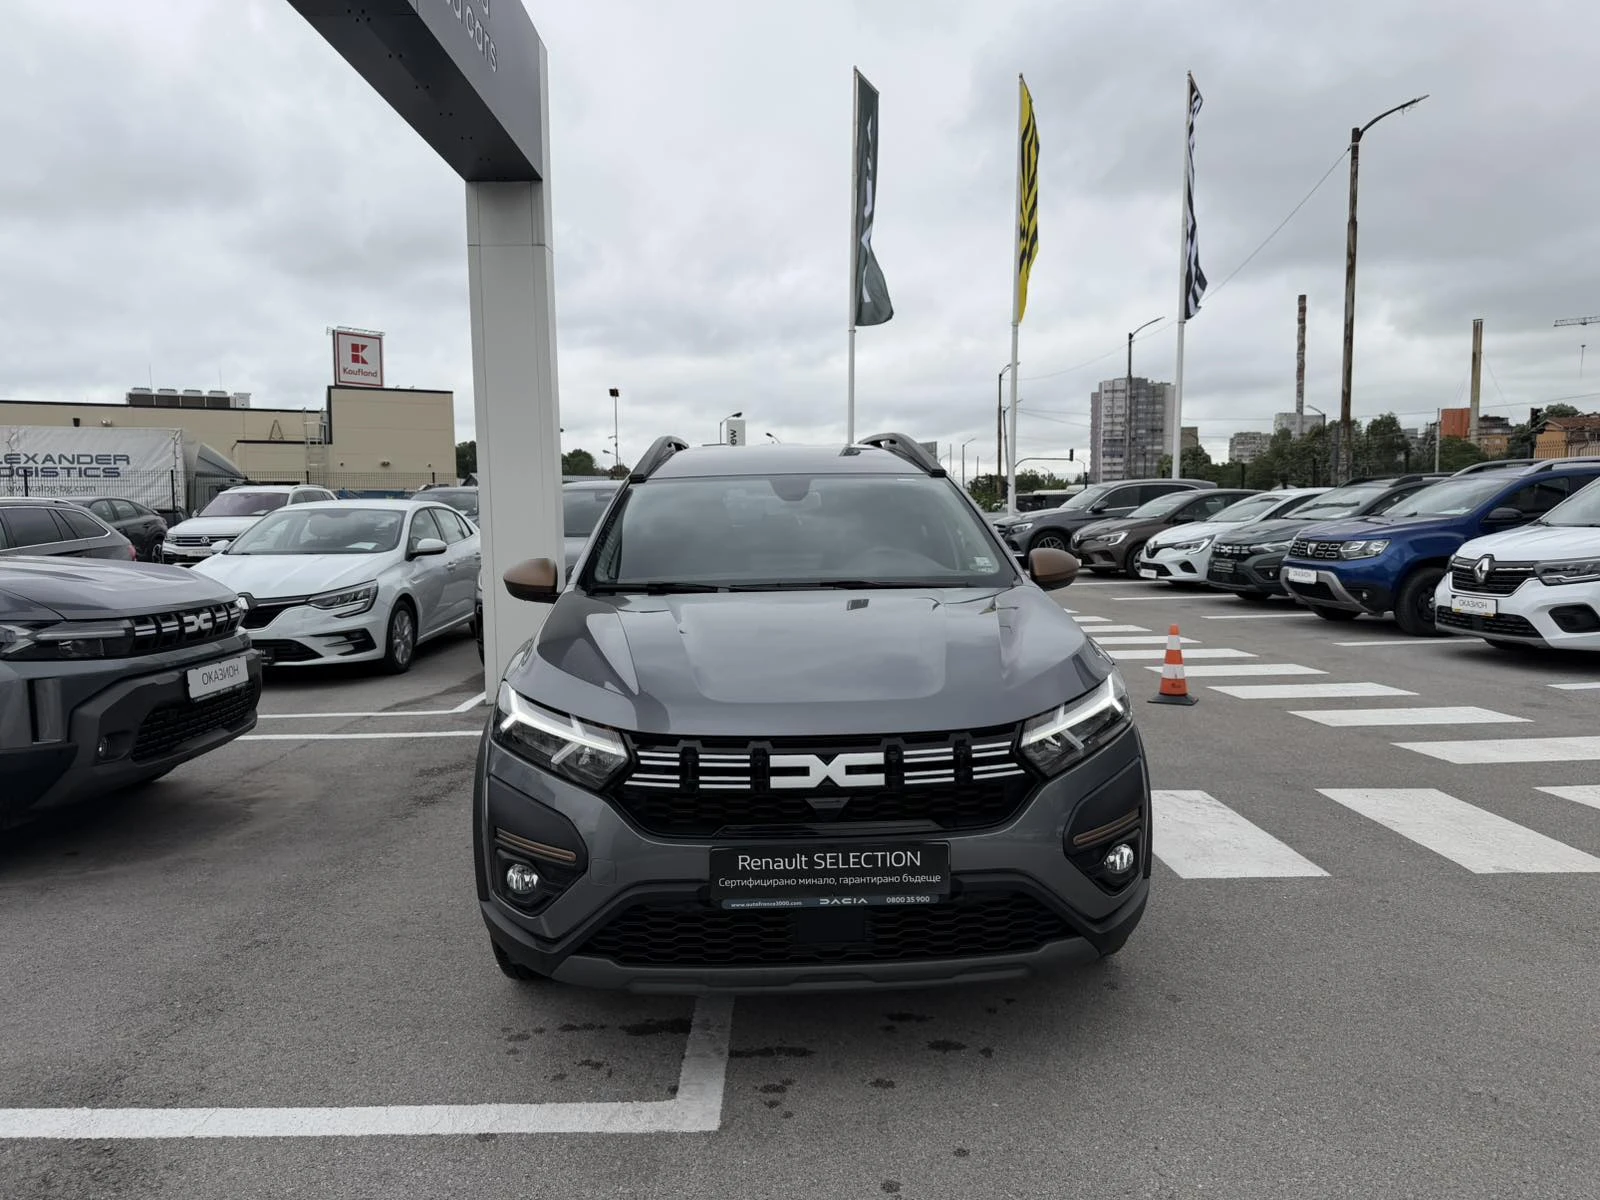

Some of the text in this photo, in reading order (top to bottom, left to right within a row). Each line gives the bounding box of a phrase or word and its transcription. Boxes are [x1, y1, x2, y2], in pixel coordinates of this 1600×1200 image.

[466, 5, 497, 72] cars
[342, 367, 378, 378] Kaufland
[0, 453, 130, 465] EXANDER
[201, 665, 239, 686] ОКАЗИОН
[738, 851, 921, 871] Renault SELECTION
[718, 873, 941, 889] Сертифицирано минало, гарантирано бъдеще
[820, 897, 868, 905] DACIA
